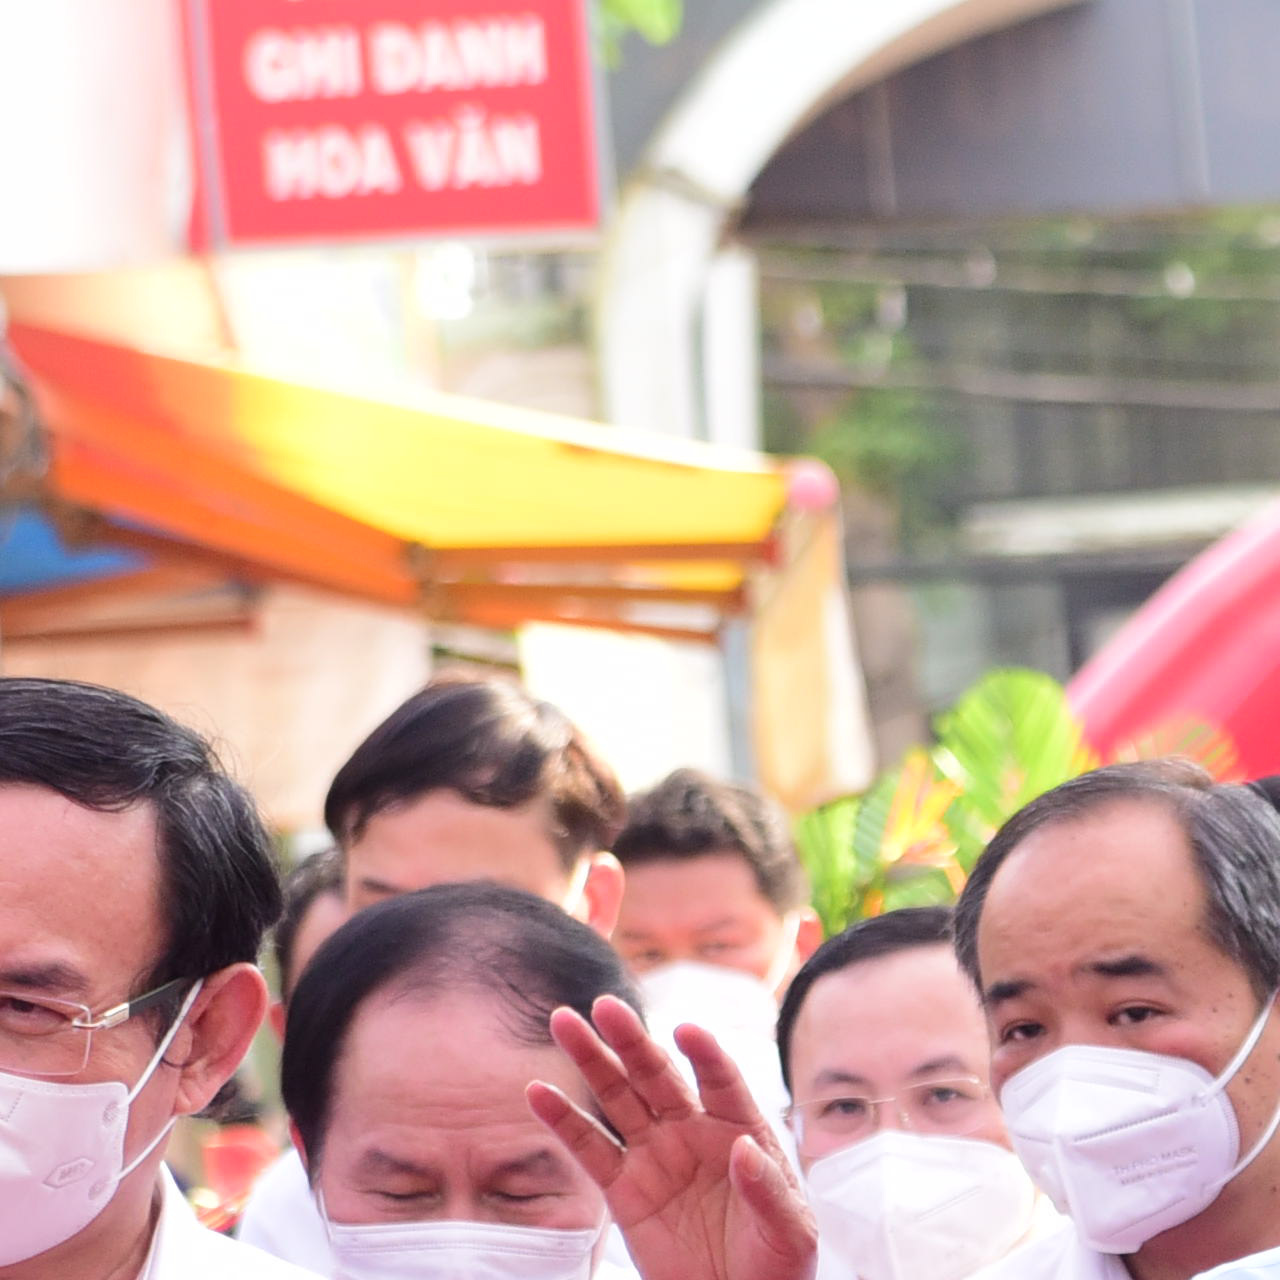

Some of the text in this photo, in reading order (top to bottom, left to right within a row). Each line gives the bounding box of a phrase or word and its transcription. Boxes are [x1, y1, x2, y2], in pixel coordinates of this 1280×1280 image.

[244, 14, 547, 102] GHI DANH
[261, 103, 542, 200] HOA VĂN
